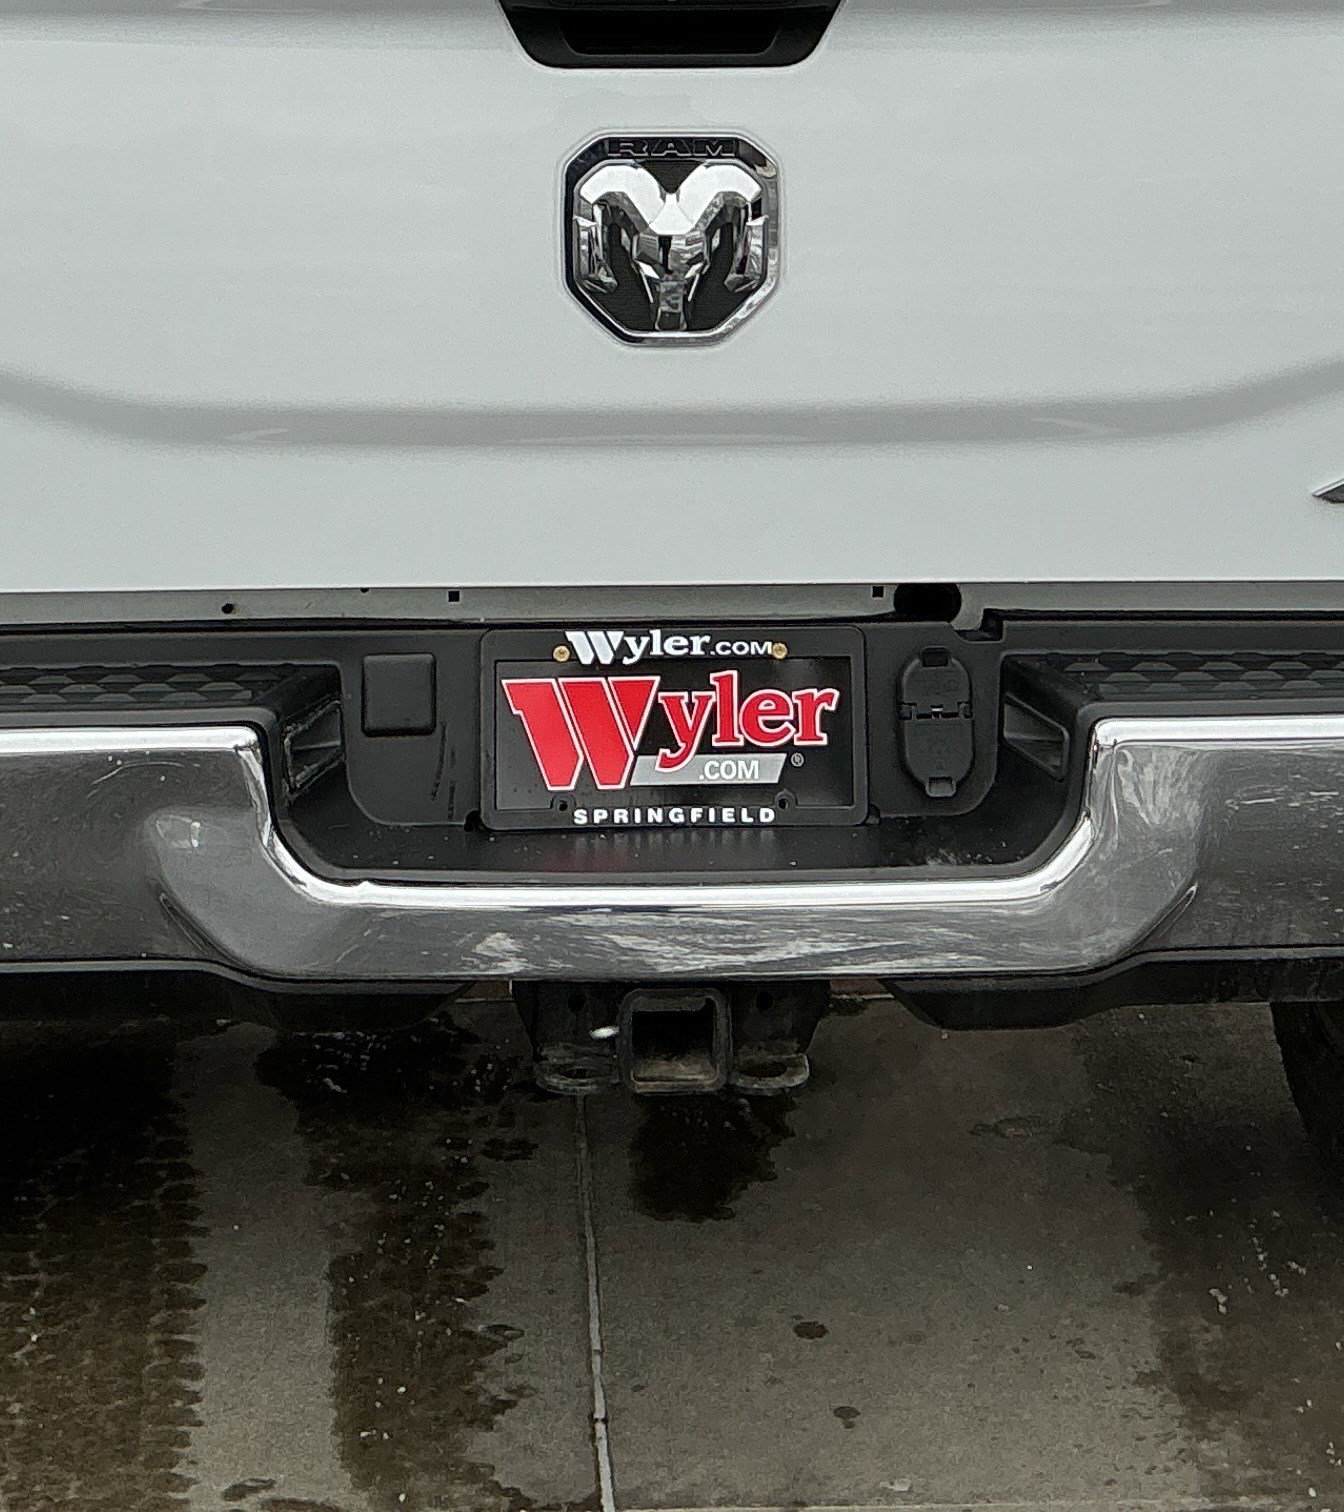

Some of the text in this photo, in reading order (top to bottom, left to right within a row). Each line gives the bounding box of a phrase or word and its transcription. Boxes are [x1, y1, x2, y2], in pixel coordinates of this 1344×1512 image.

[606, 138, 736, 157] RAM
[501, 670, 839, 790] Wyler
[574, 808, 775, 824] SPRINGFIELD
